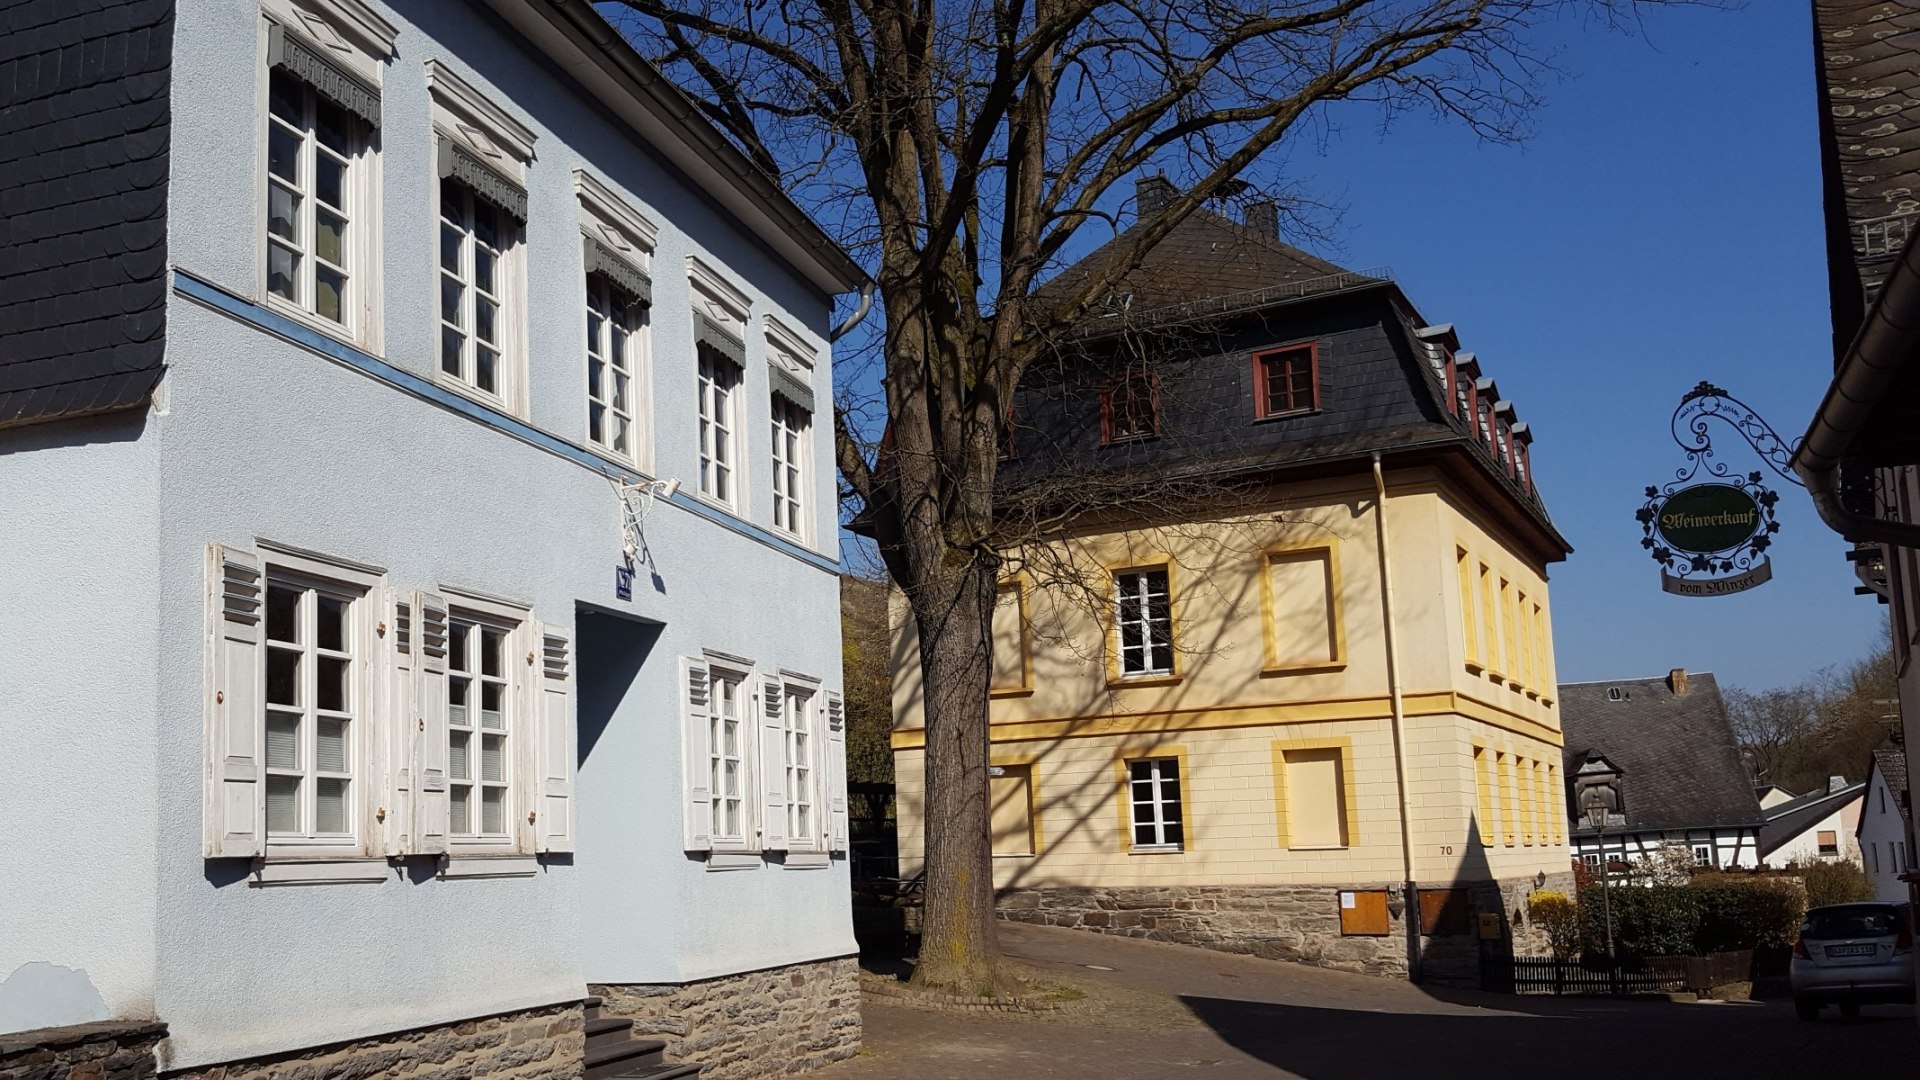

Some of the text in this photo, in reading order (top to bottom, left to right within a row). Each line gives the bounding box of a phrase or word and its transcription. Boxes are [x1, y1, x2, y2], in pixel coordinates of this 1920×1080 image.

[1661, 507, 1756, 530] Weinverkauf
[1680, 574, 1755, 594] vom Winzer
[1440, 846, 1453, 855] 70
